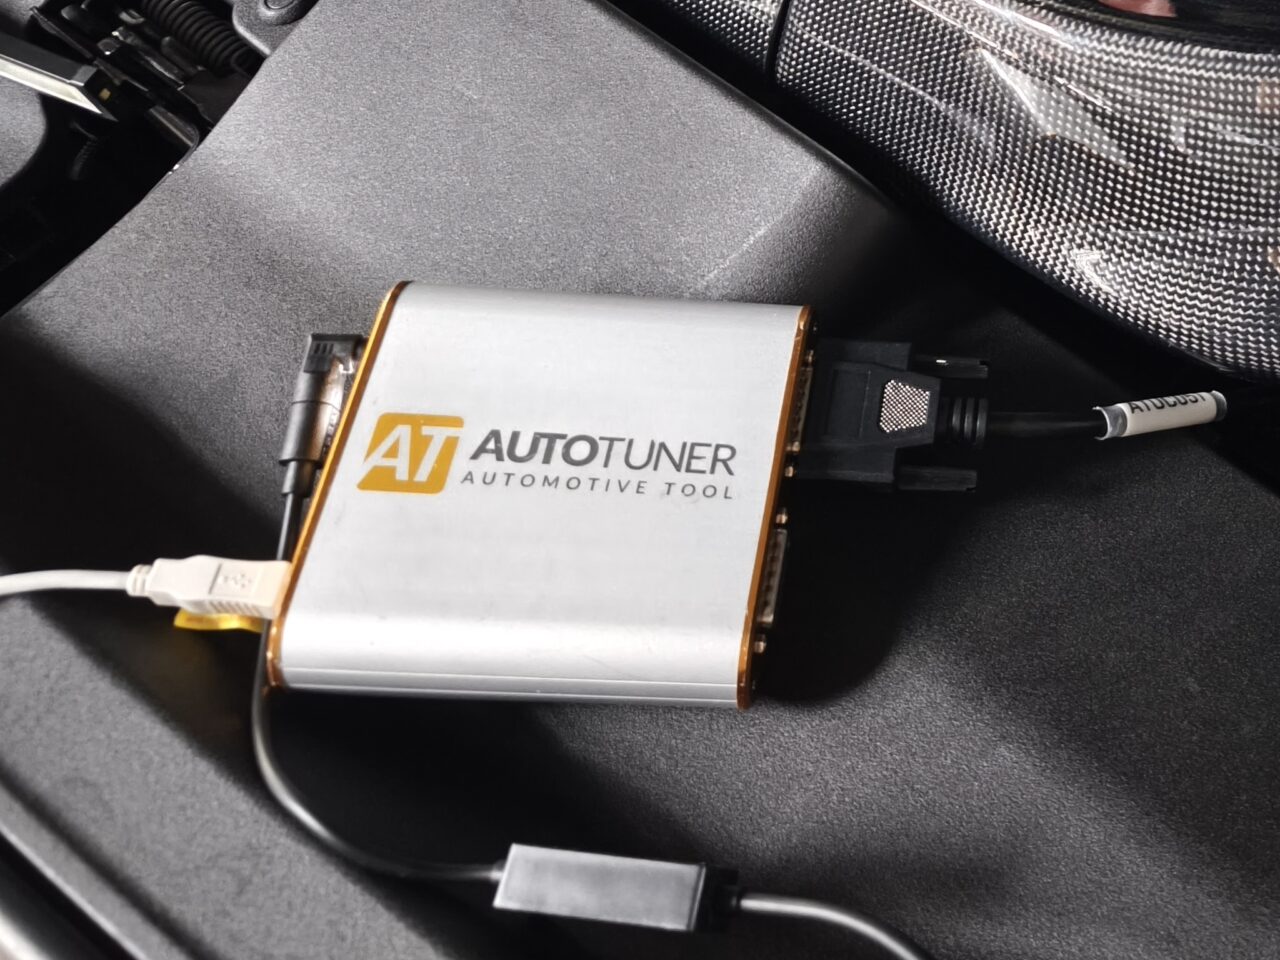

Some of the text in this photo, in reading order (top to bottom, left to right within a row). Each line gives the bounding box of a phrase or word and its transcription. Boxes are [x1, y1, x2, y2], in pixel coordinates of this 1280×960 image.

[364, 423, 465, 483] AT
[469, 429, 737, 476] AUTOTUNER
[460, 470, 734, 499] AUTOMOTIVE TOOL
